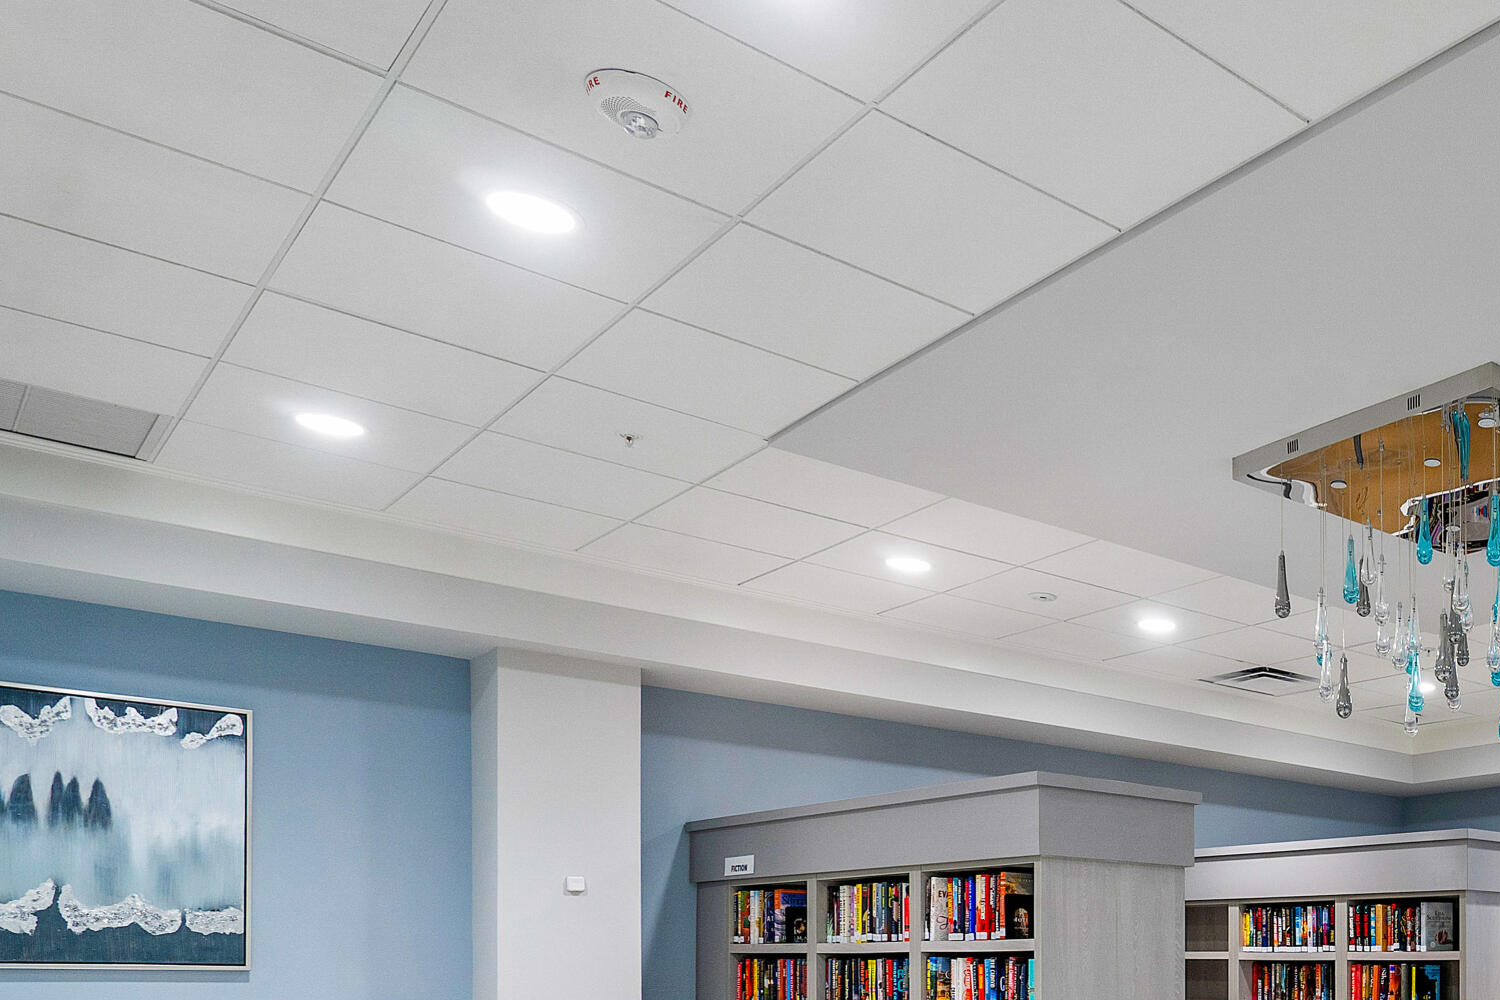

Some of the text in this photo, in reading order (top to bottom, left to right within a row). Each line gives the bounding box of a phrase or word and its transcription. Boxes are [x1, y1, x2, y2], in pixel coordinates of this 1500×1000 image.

[585, 76, 600, 96] FIRE
[664, 90, 689, 114] FIRE
[731, 864, 748, 873] FICTION
